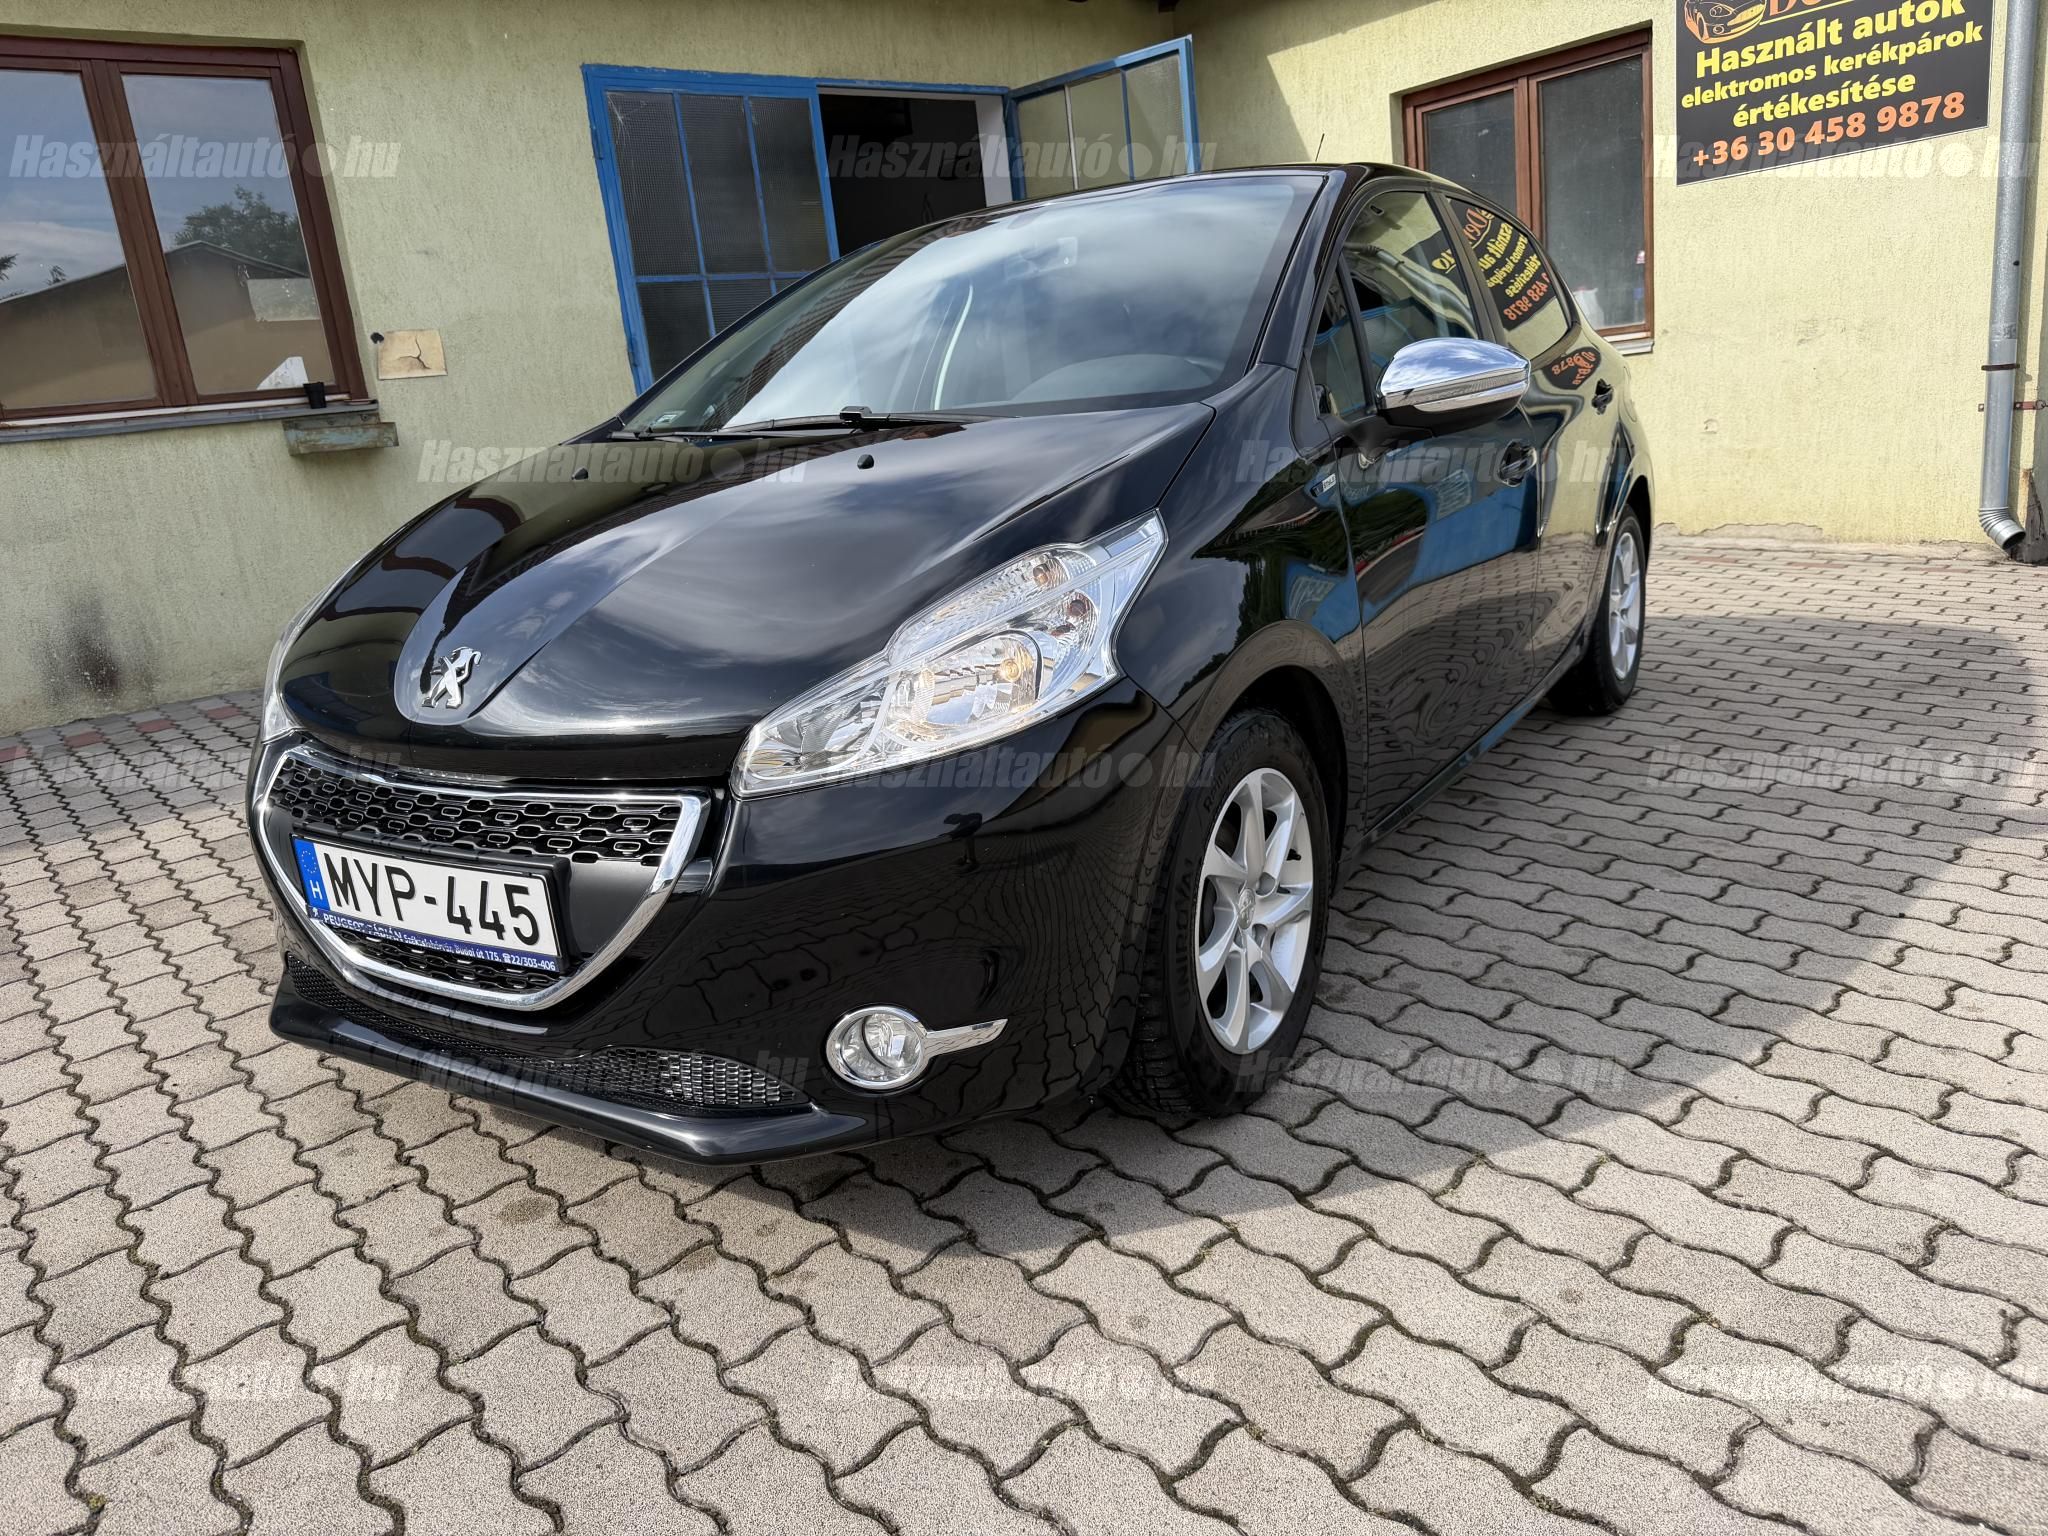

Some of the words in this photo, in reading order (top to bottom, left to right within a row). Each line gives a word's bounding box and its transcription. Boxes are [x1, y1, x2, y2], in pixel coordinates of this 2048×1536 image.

[1681, 65, 1817, 108] elektromos
[1824, 22, 1982, 75] kerékpárok
[1696, 19, 1843, 78] Használt
[1693, 136, 1748, 166] +36
[1759, 127, 1796, 155] 30
[1805, 112, 1866, 144] 458
[1877, 92, 1965, 132] 9878
[1733, 73, 1917, 128] értékesítése
[309, 880, 324, 901] H
[324, 852, 540, 946] MYP-445
